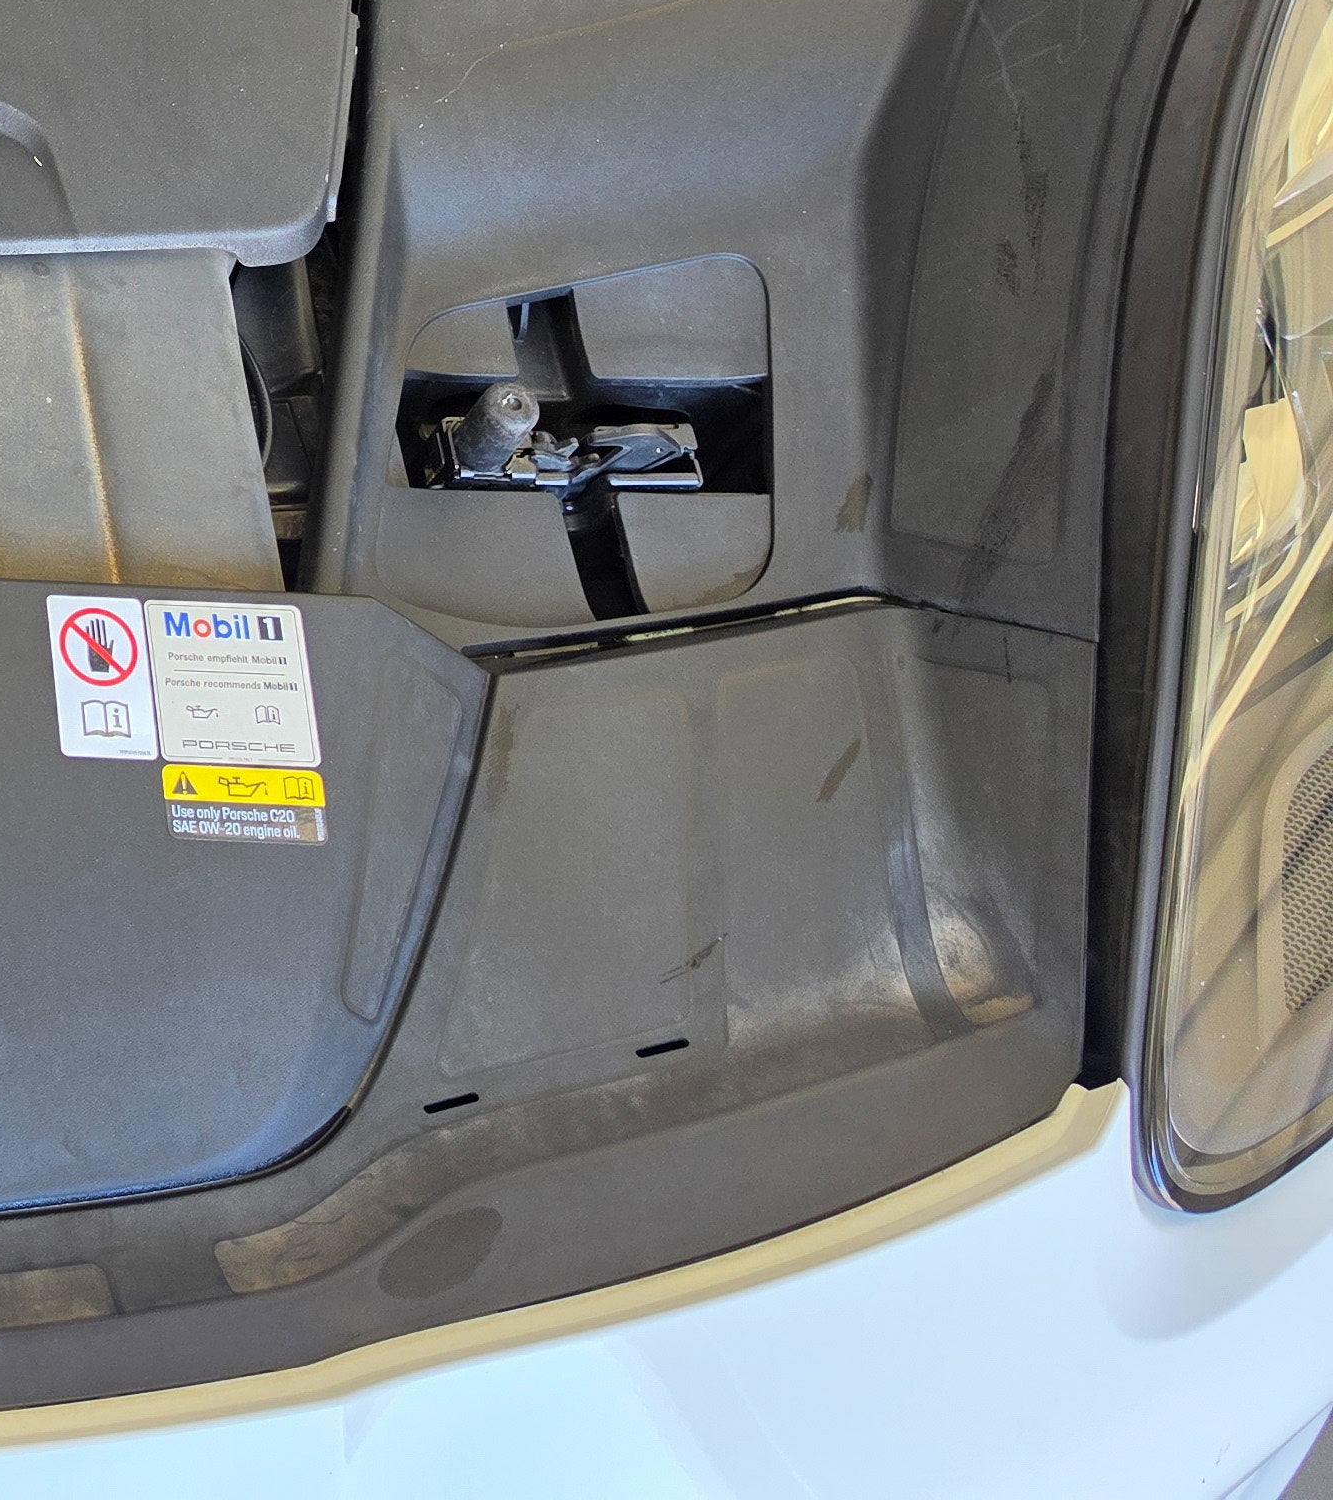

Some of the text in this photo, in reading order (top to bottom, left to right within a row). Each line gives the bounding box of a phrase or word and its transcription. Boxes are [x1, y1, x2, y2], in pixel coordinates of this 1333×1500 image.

[163, 611, 250, 639] Mobil
[167, 651, 204, 662] Porsche
[251, 655, 278, 665] Mobil
[165, 677, 201, 687] Porsche
[203, 680, 262, 690] recommends
[263, 681, 289, 691] Mobil
[183, 739, 296, 753] PORSCHE
[171, 804, 295, 824] Use only Porsche C20
[173, 820, 198, 833] SAE
[243, 824, 281, 840] engine
[283, 825, 301, 839] oil.
